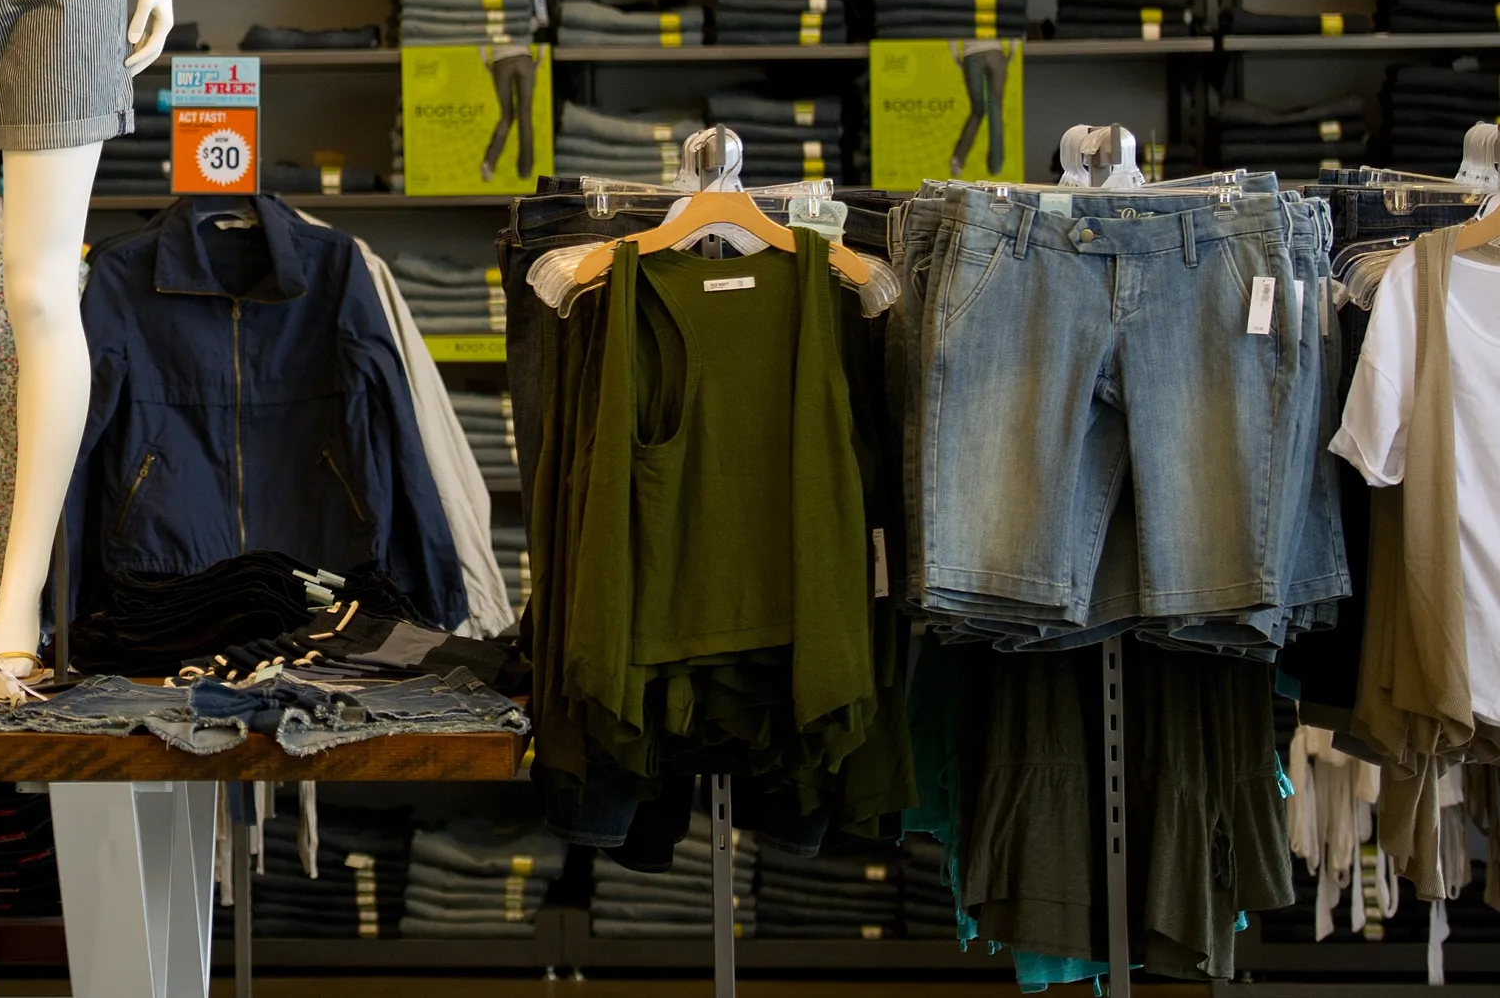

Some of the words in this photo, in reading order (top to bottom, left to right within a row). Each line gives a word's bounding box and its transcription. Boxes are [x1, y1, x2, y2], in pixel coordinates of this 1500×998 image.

[177, 72, 194, 86] BUY
[194, 72, 201, 86] 2
[228, 64, 239, 82] 1
[178, 112, 197, 123] ACT
[199, 112, 227, 123] FAST!
[202, 146, 240, 170] $30
